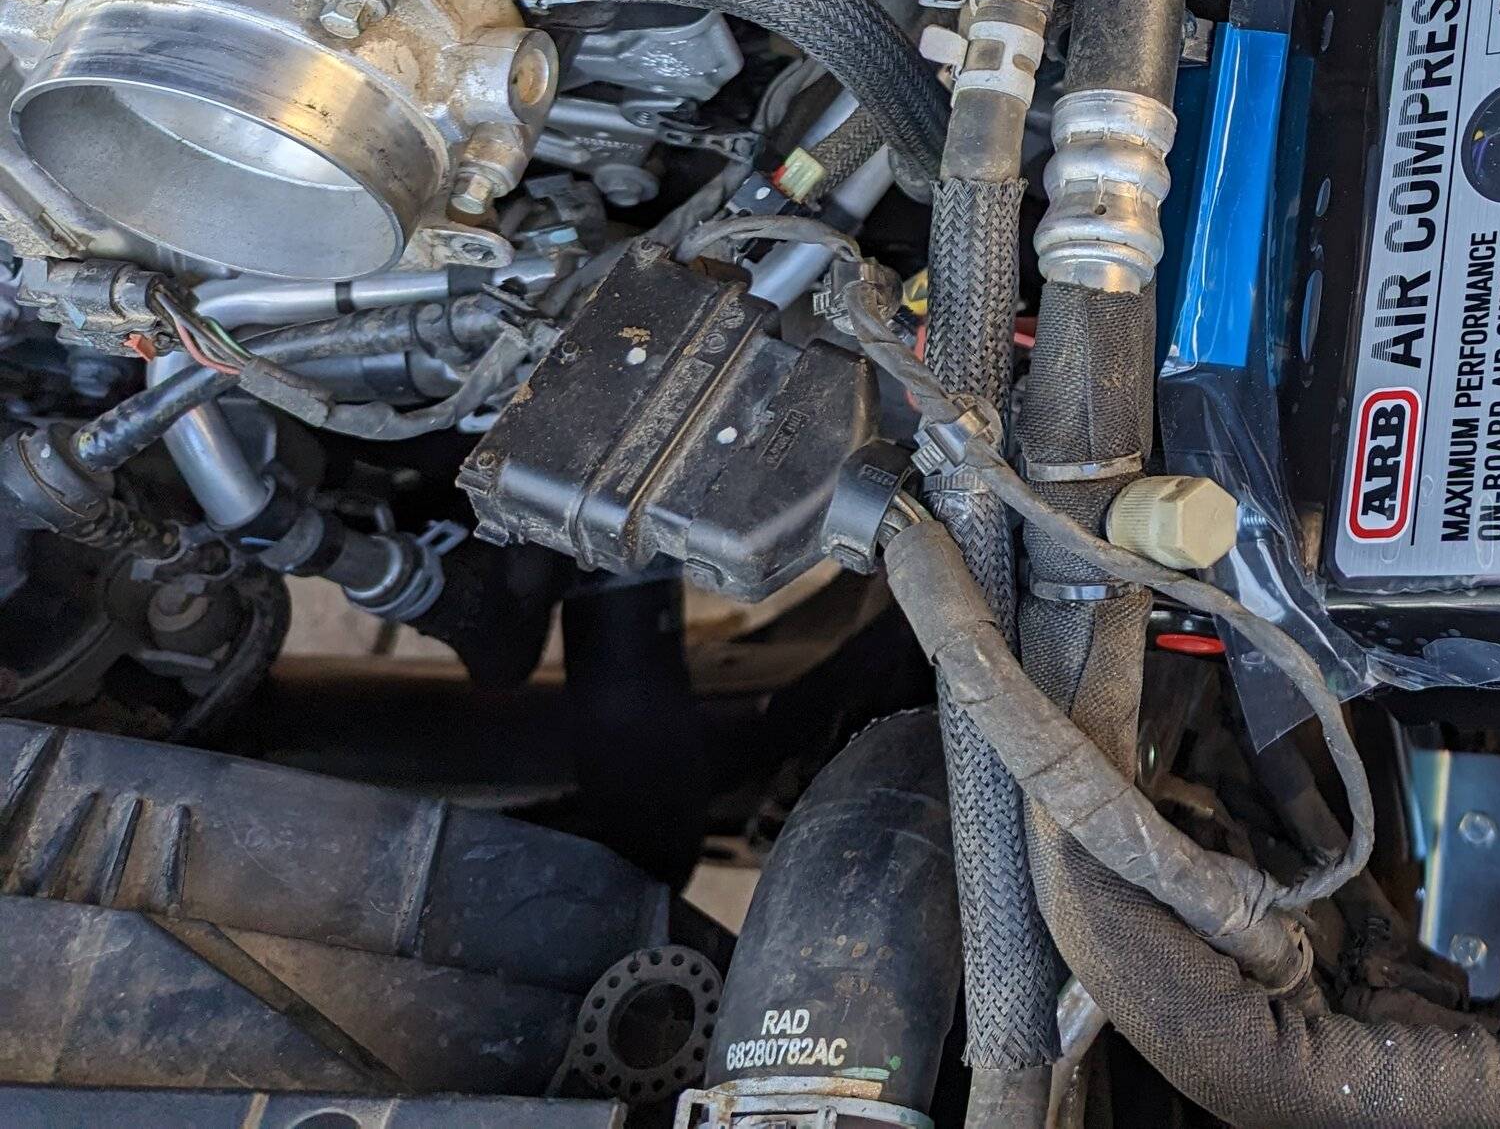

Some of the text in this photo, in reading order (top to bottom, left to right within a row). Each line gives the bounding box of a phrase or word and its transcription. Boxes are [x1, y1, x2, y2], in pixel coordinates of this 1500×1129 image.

[1371, 270, 1431, 369] AIR
[1441, 230, 1497, 542] MAXIMUM PERFORMANCE
[1361, 403, 1406, 521] ARB
[726, 1037, 848, 1071] 68280782AC
[760, 1008, 810, 1036] RAD
